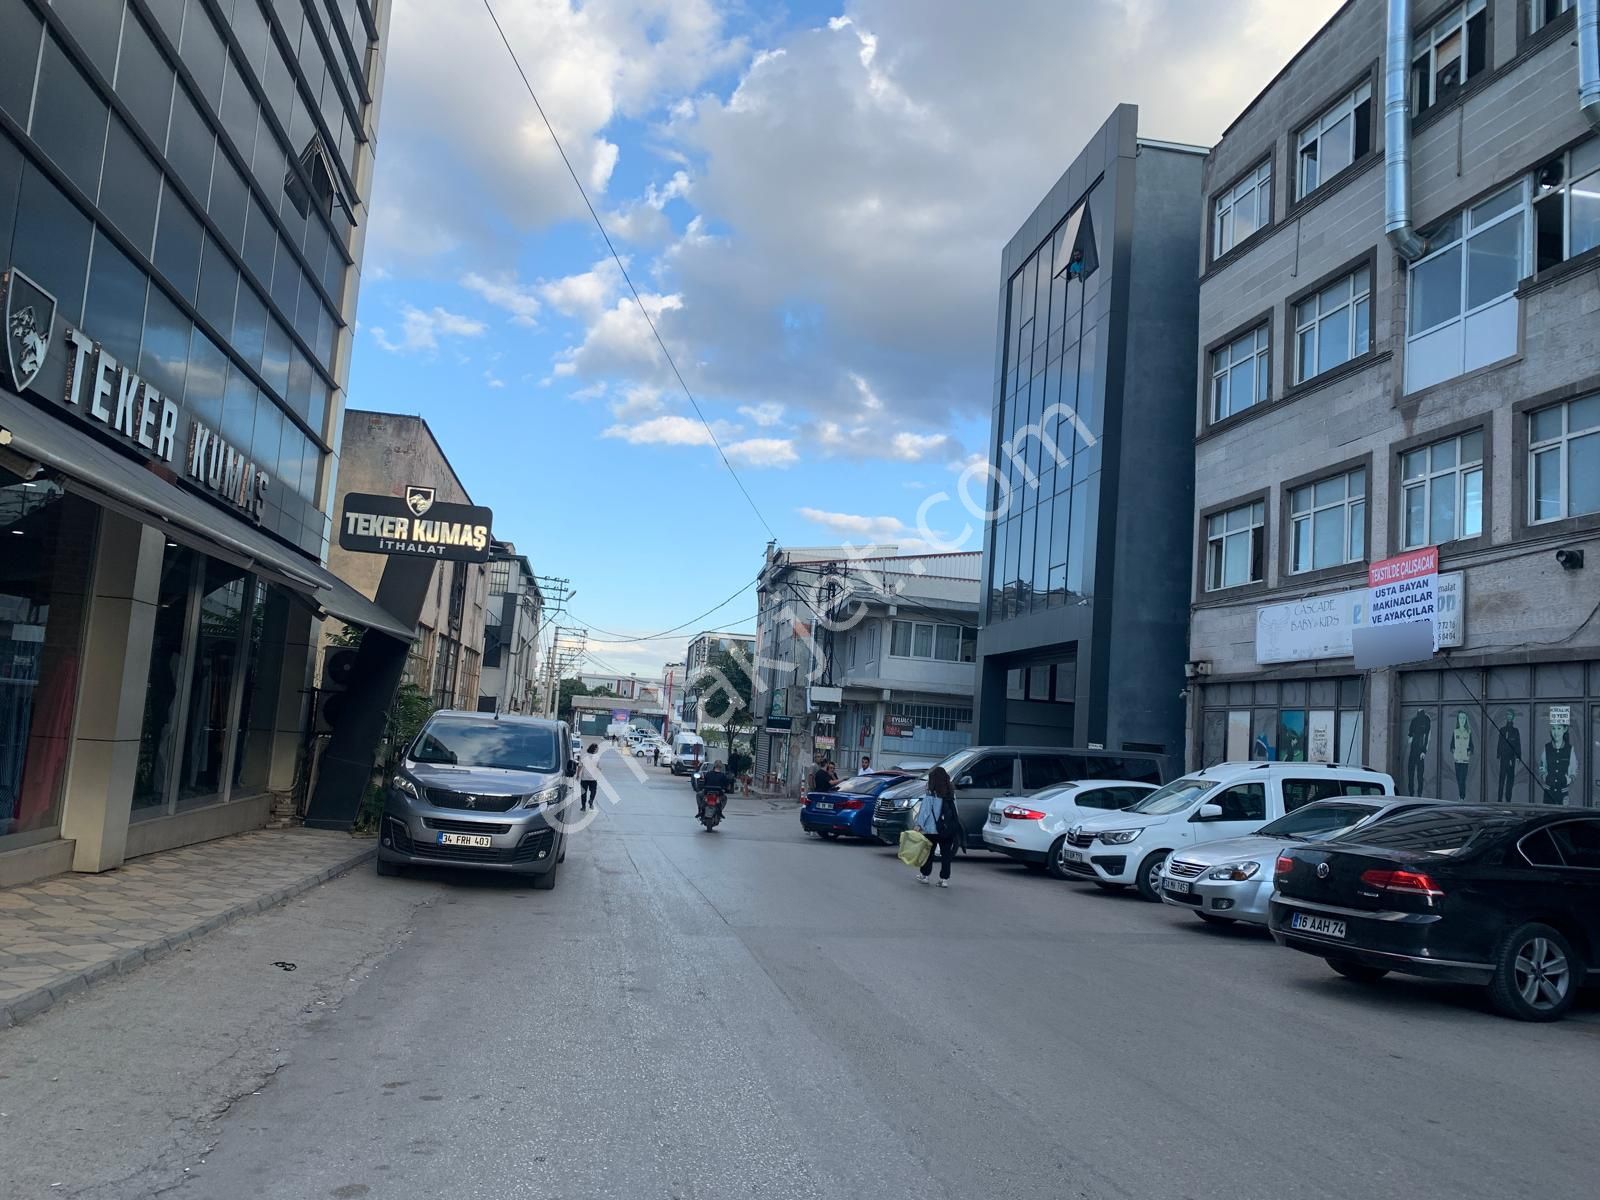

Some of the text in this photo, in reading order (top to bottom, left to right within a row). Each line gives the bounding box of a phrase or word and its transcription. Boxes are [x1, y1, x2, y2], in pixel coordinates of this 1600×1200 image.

[65, 328, 269, 526] TEKER KUMAŞ
[345, 511, 488, 551] TEKER KUMAŞ
[379, 539, 447, 555] İTHALAT
[1400, 554, 1435, 578] ÇALIŞACAK
[1375, 579, 1429, 599] USTA BAYAN
[1294, 599, 1336, 617] CASCADE
[1372, 591, 1433, 612] MAKİNACILAR
[1372, 604, 1434, 624] VE AYAKÇILAR
[443, 834, 489, 846] 34 FRH 403
[1299, 915, 1345, 935] 16 AAH 74
